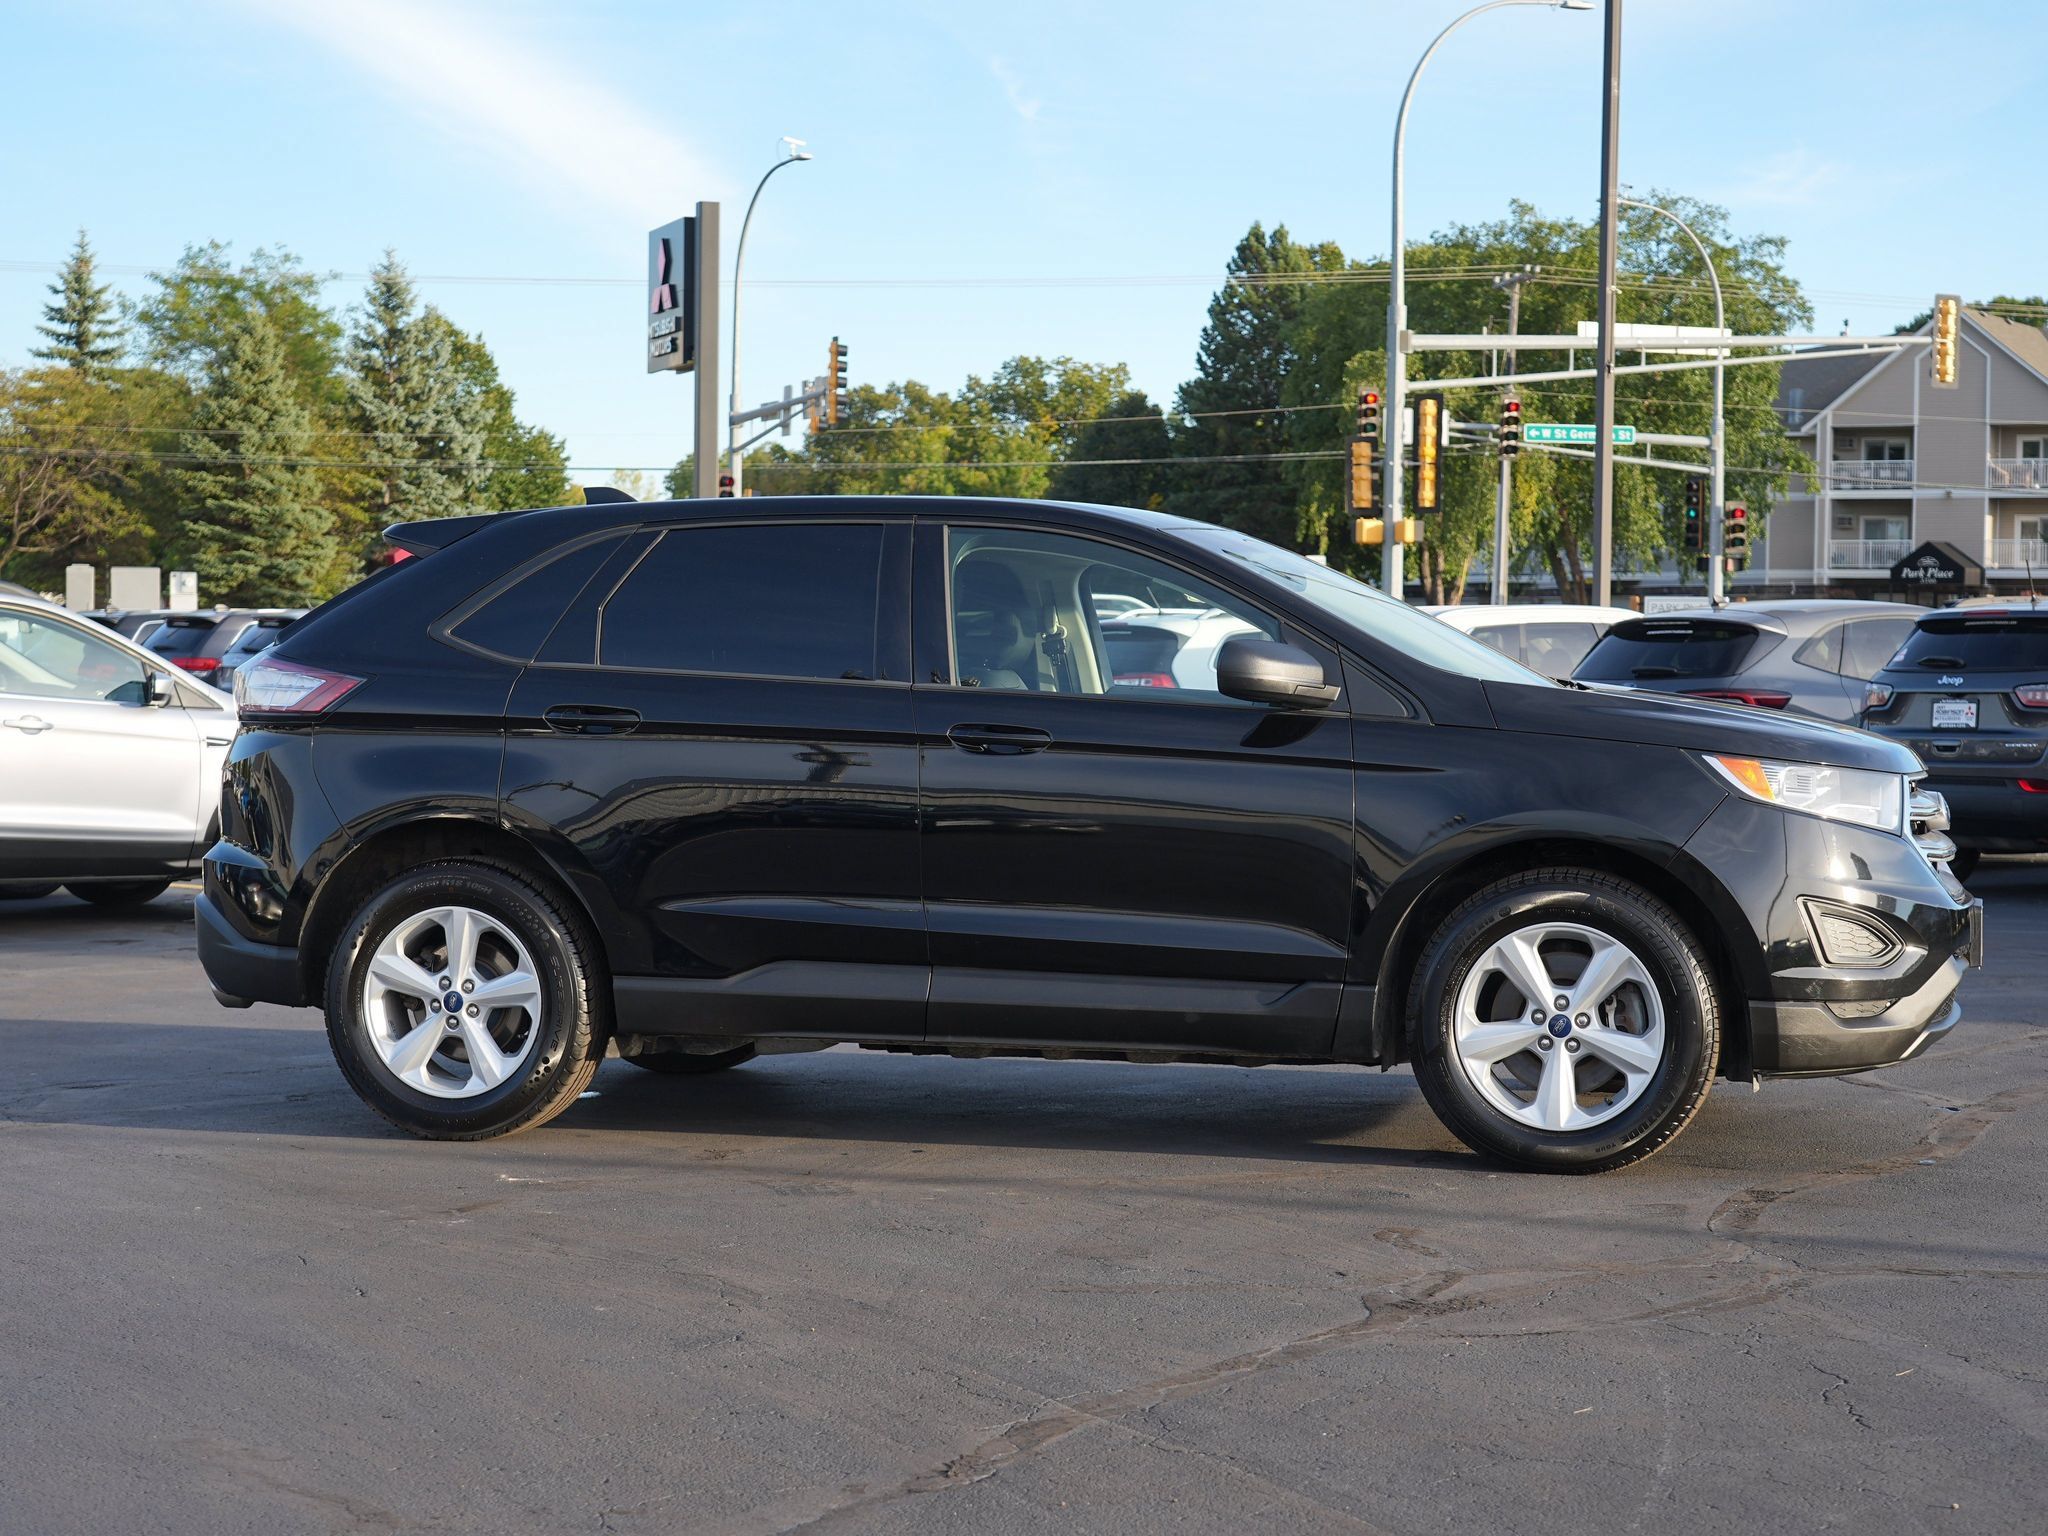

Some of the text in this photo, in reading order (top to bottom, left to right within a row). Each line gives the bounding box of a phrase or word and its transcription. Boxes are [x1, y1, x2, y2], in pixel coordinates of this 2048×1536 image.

[1541, 428, 1552, 438] W
[1554, 428, 1567, 439] St
[1618, 430, 1631, 440] St
[1901, 567, 1954, 578] Park Place
[1937, 675, 1964, 687] Jeep
